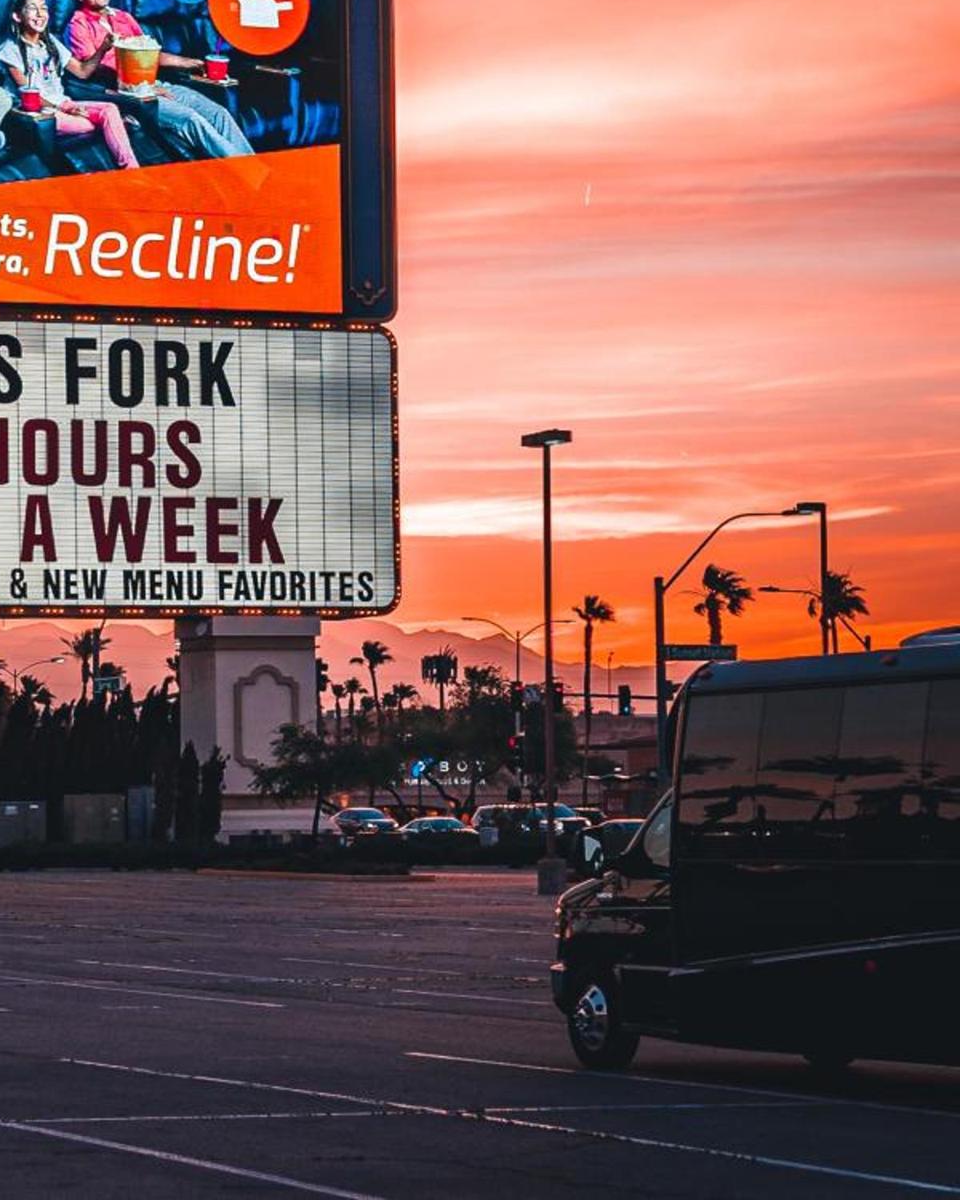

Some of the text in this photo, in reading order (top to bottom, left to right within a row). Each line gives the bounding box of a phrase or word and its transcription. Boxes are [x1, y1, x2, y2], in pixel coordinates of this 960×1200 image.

[43, 212, 302, 284] Recline!
[64, 337, 236, 407] FORK
[20, 496, 56, 562] A
[87, 496, 285, 564] WEEK
[10, 569, 28, 600] &
[44, 570, 106, 601] NEW
[123, 571, 204, 601] MENU
[219, 570, 375, 603] FAVORITES
